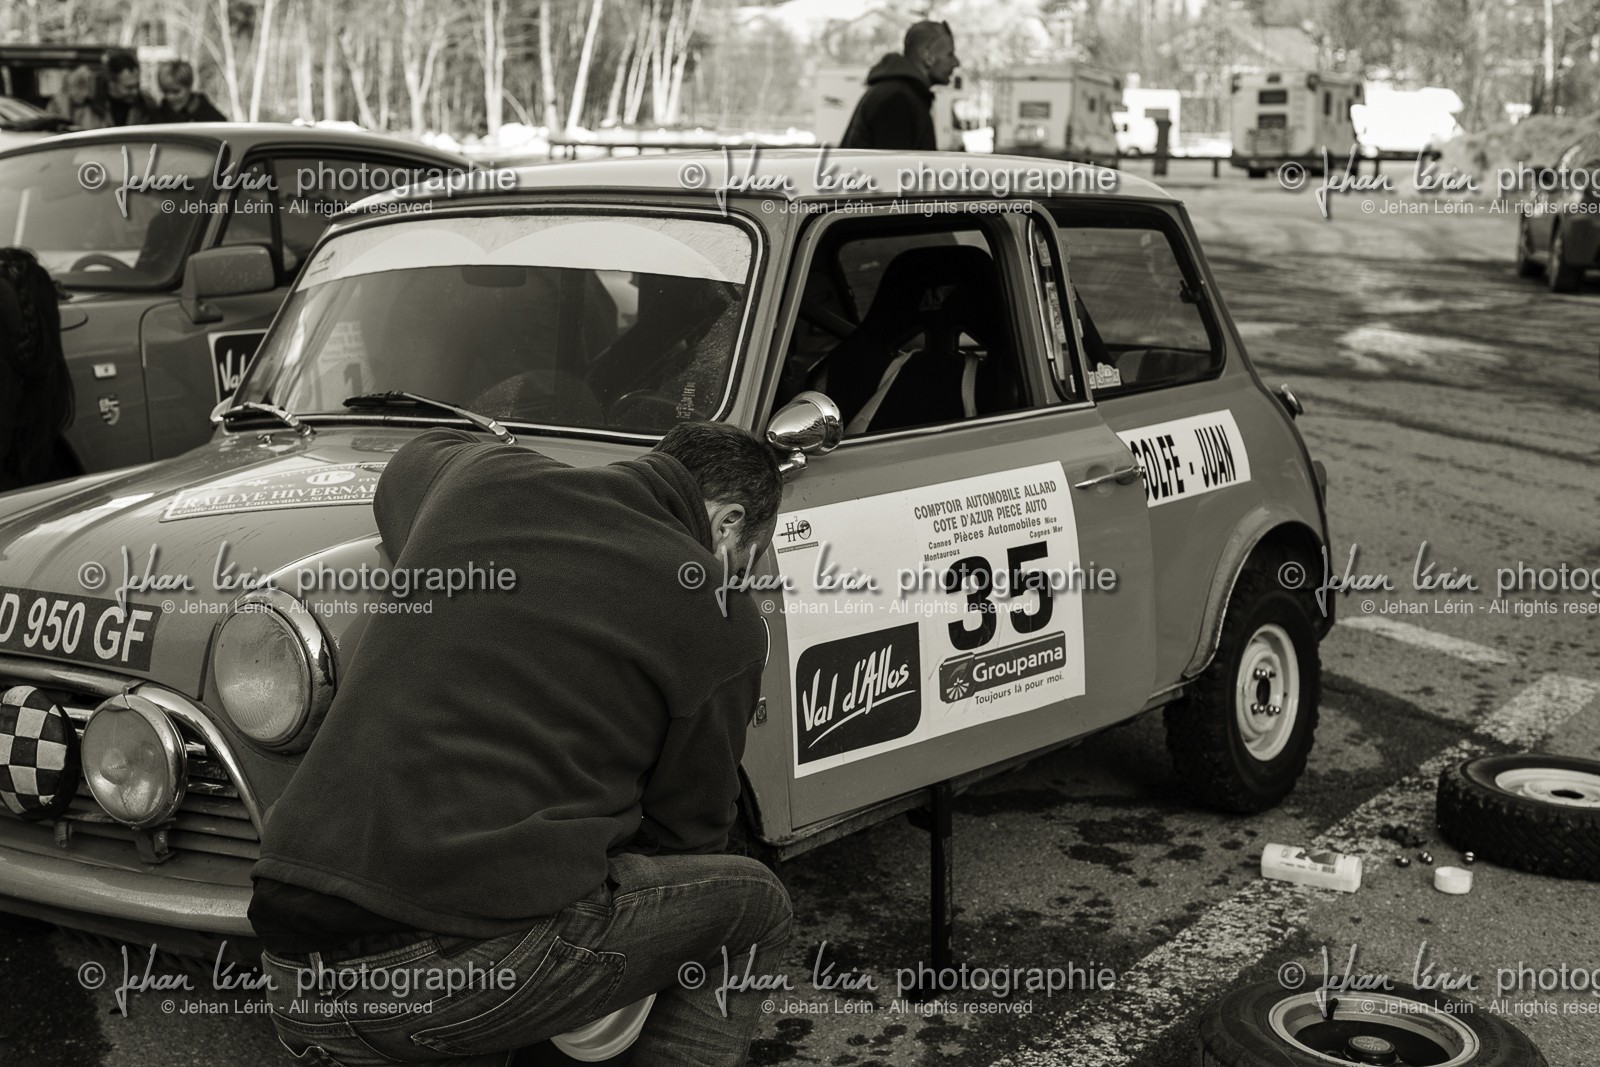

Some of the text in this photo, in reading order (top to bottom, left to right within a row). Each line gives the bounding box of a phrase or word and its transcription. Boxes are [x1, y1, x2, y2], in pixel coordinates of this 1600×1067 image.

[220, 349, 246, 391] Val
[1194, 425, 1236, 488] JUAN
[183, 491, 268, 509] RALLYE
[914, 480, 1057, 520] COMPTOIR AUTOMOBILE ALLARD
[933, 498, 1048, 533] COTE D'AZUR PIECE AUTO
[928, 539, 952, 550] Cannes
[953, 529, 984, 544] Pièces
[987, 517, 1041, 537] Automobiles
[924, 548, 961, 562] Montauroux
[946, 541, 1053, 651] 35
[23, 597, 86, 654] 950
[93, 606, 153, 663] GF
[972, 646, 1063, 683] Groupama
[802, 644, 910, 732] Val d'Allos
[975, 672, 1065, 705] Toujours là pour moi.
